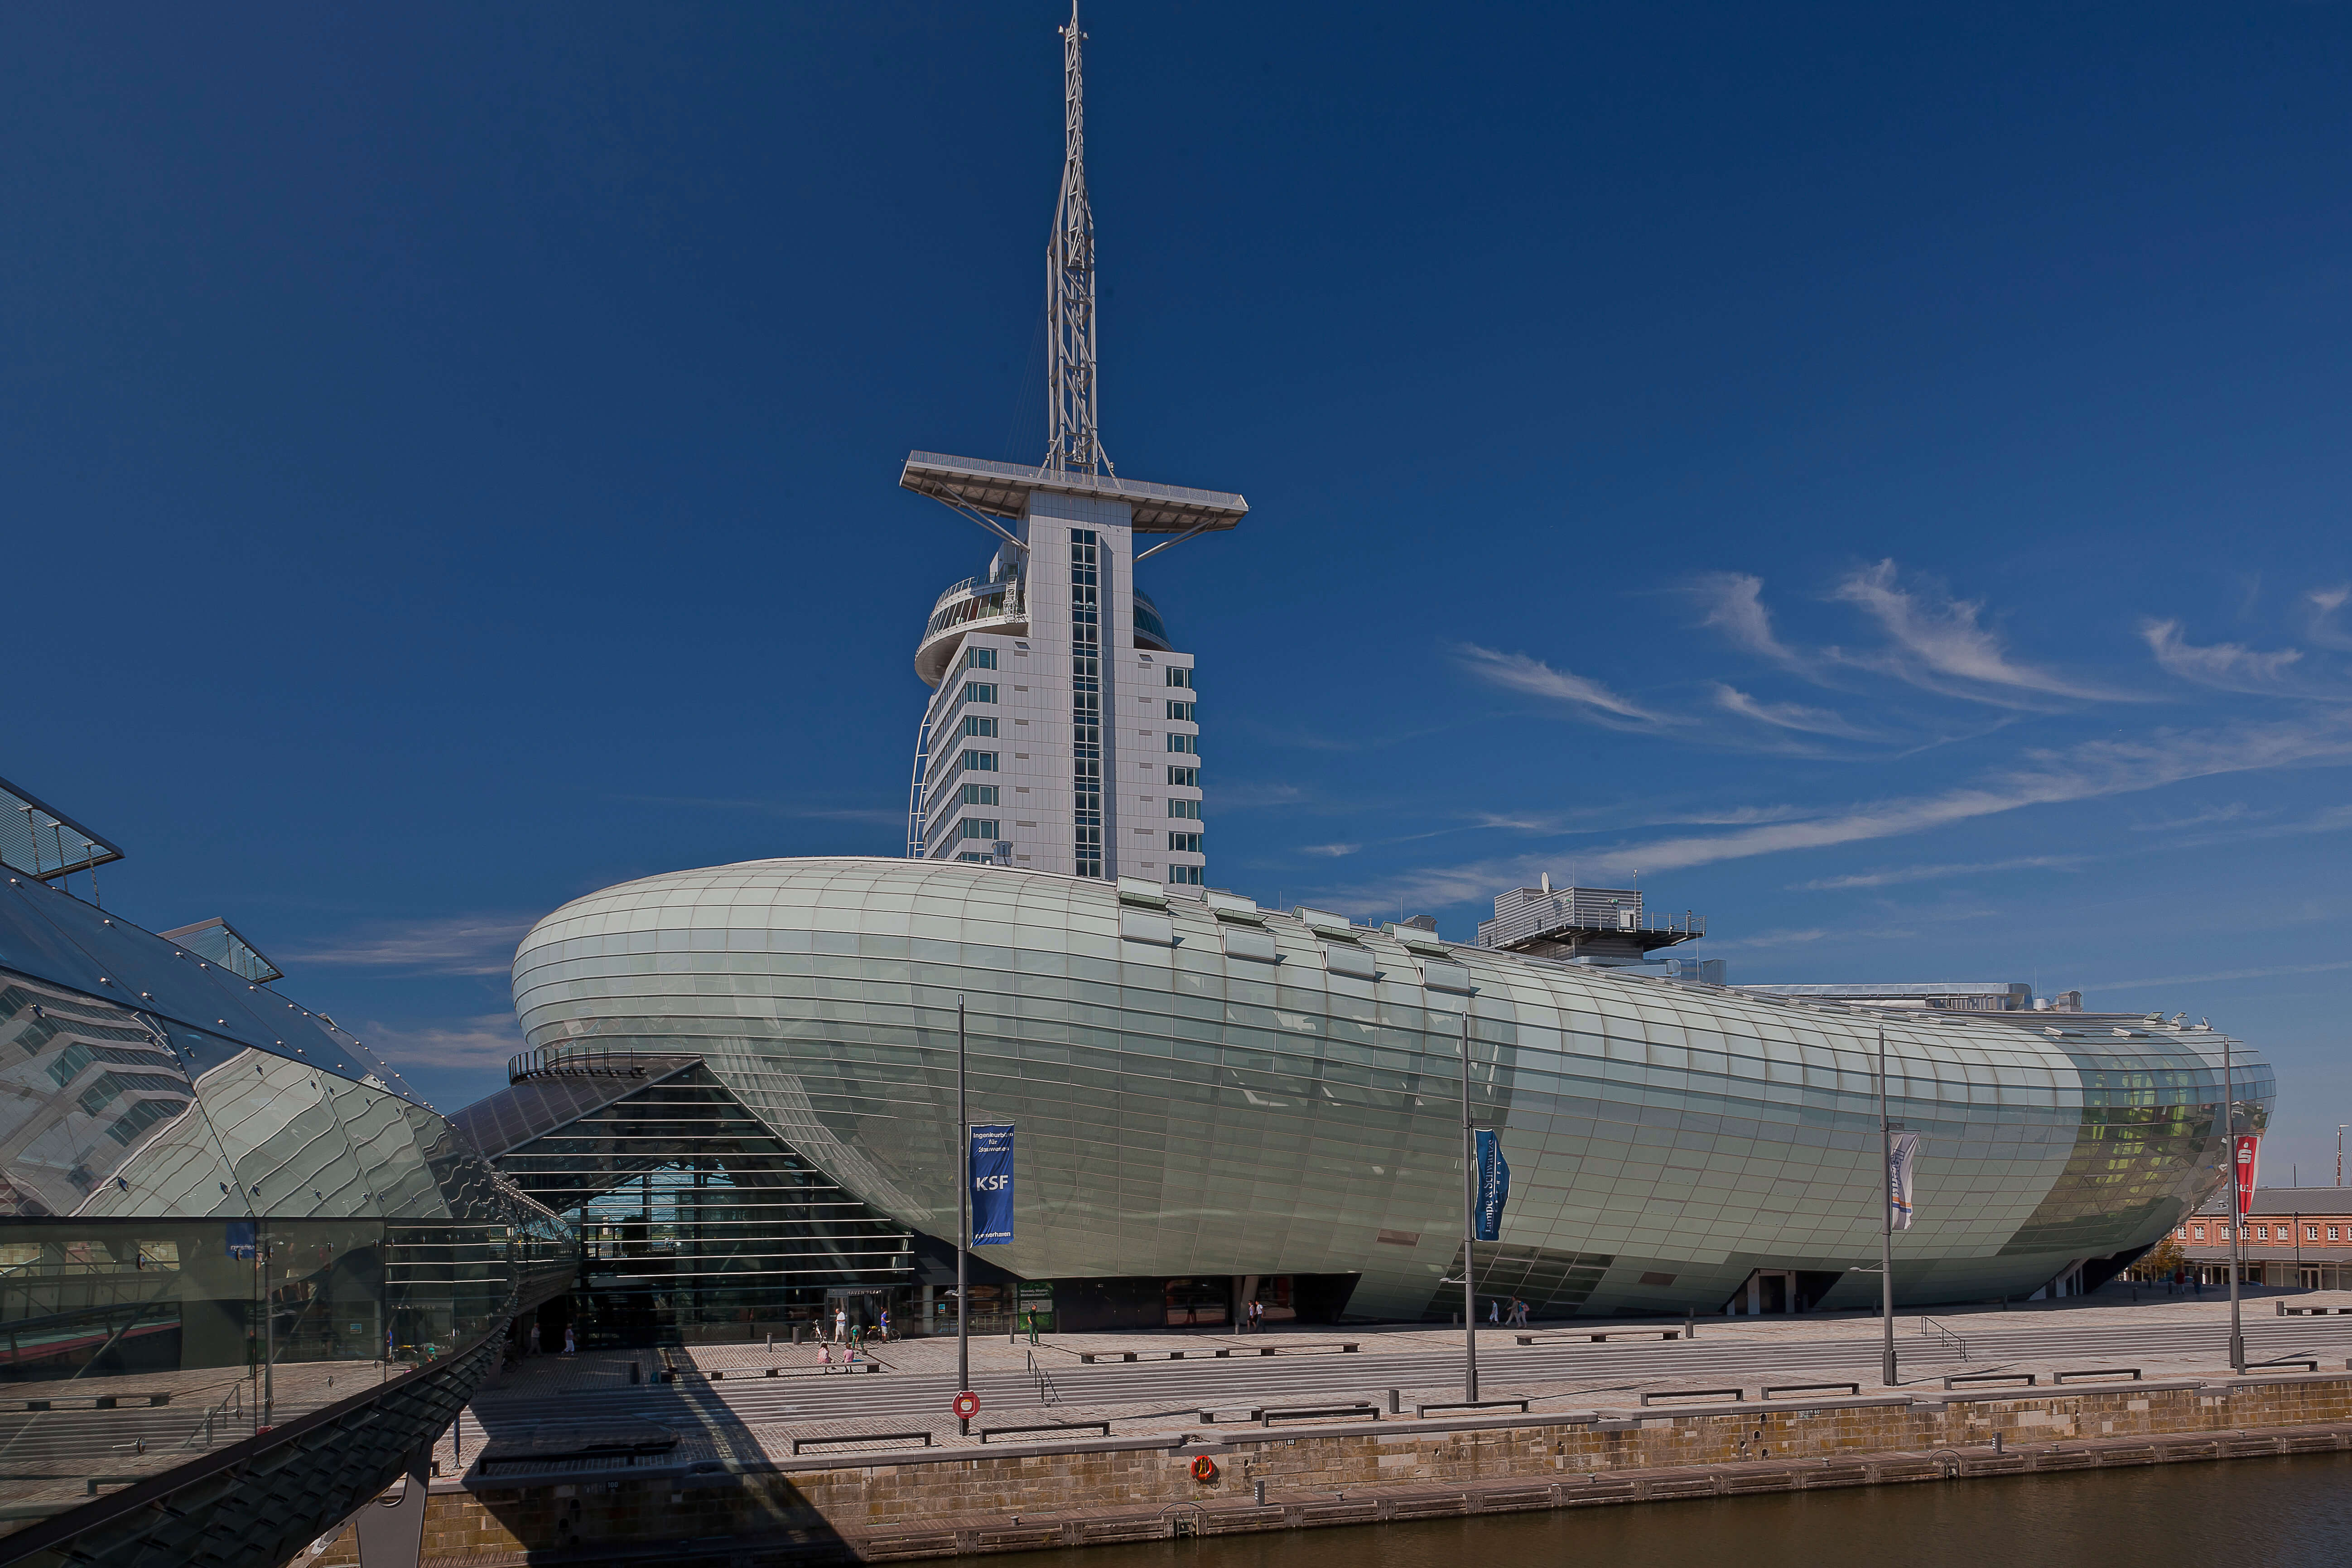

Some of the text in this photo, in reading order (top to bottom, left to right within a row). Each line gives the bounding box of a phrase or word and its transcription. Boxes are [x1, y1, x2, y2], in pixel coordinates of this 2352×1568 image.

[1484, 1140, 1494, 1188] Schwartze
[977, 1175, 1008, 1191] KSF
[1485, 1200, 1494, 1232] Lampe
